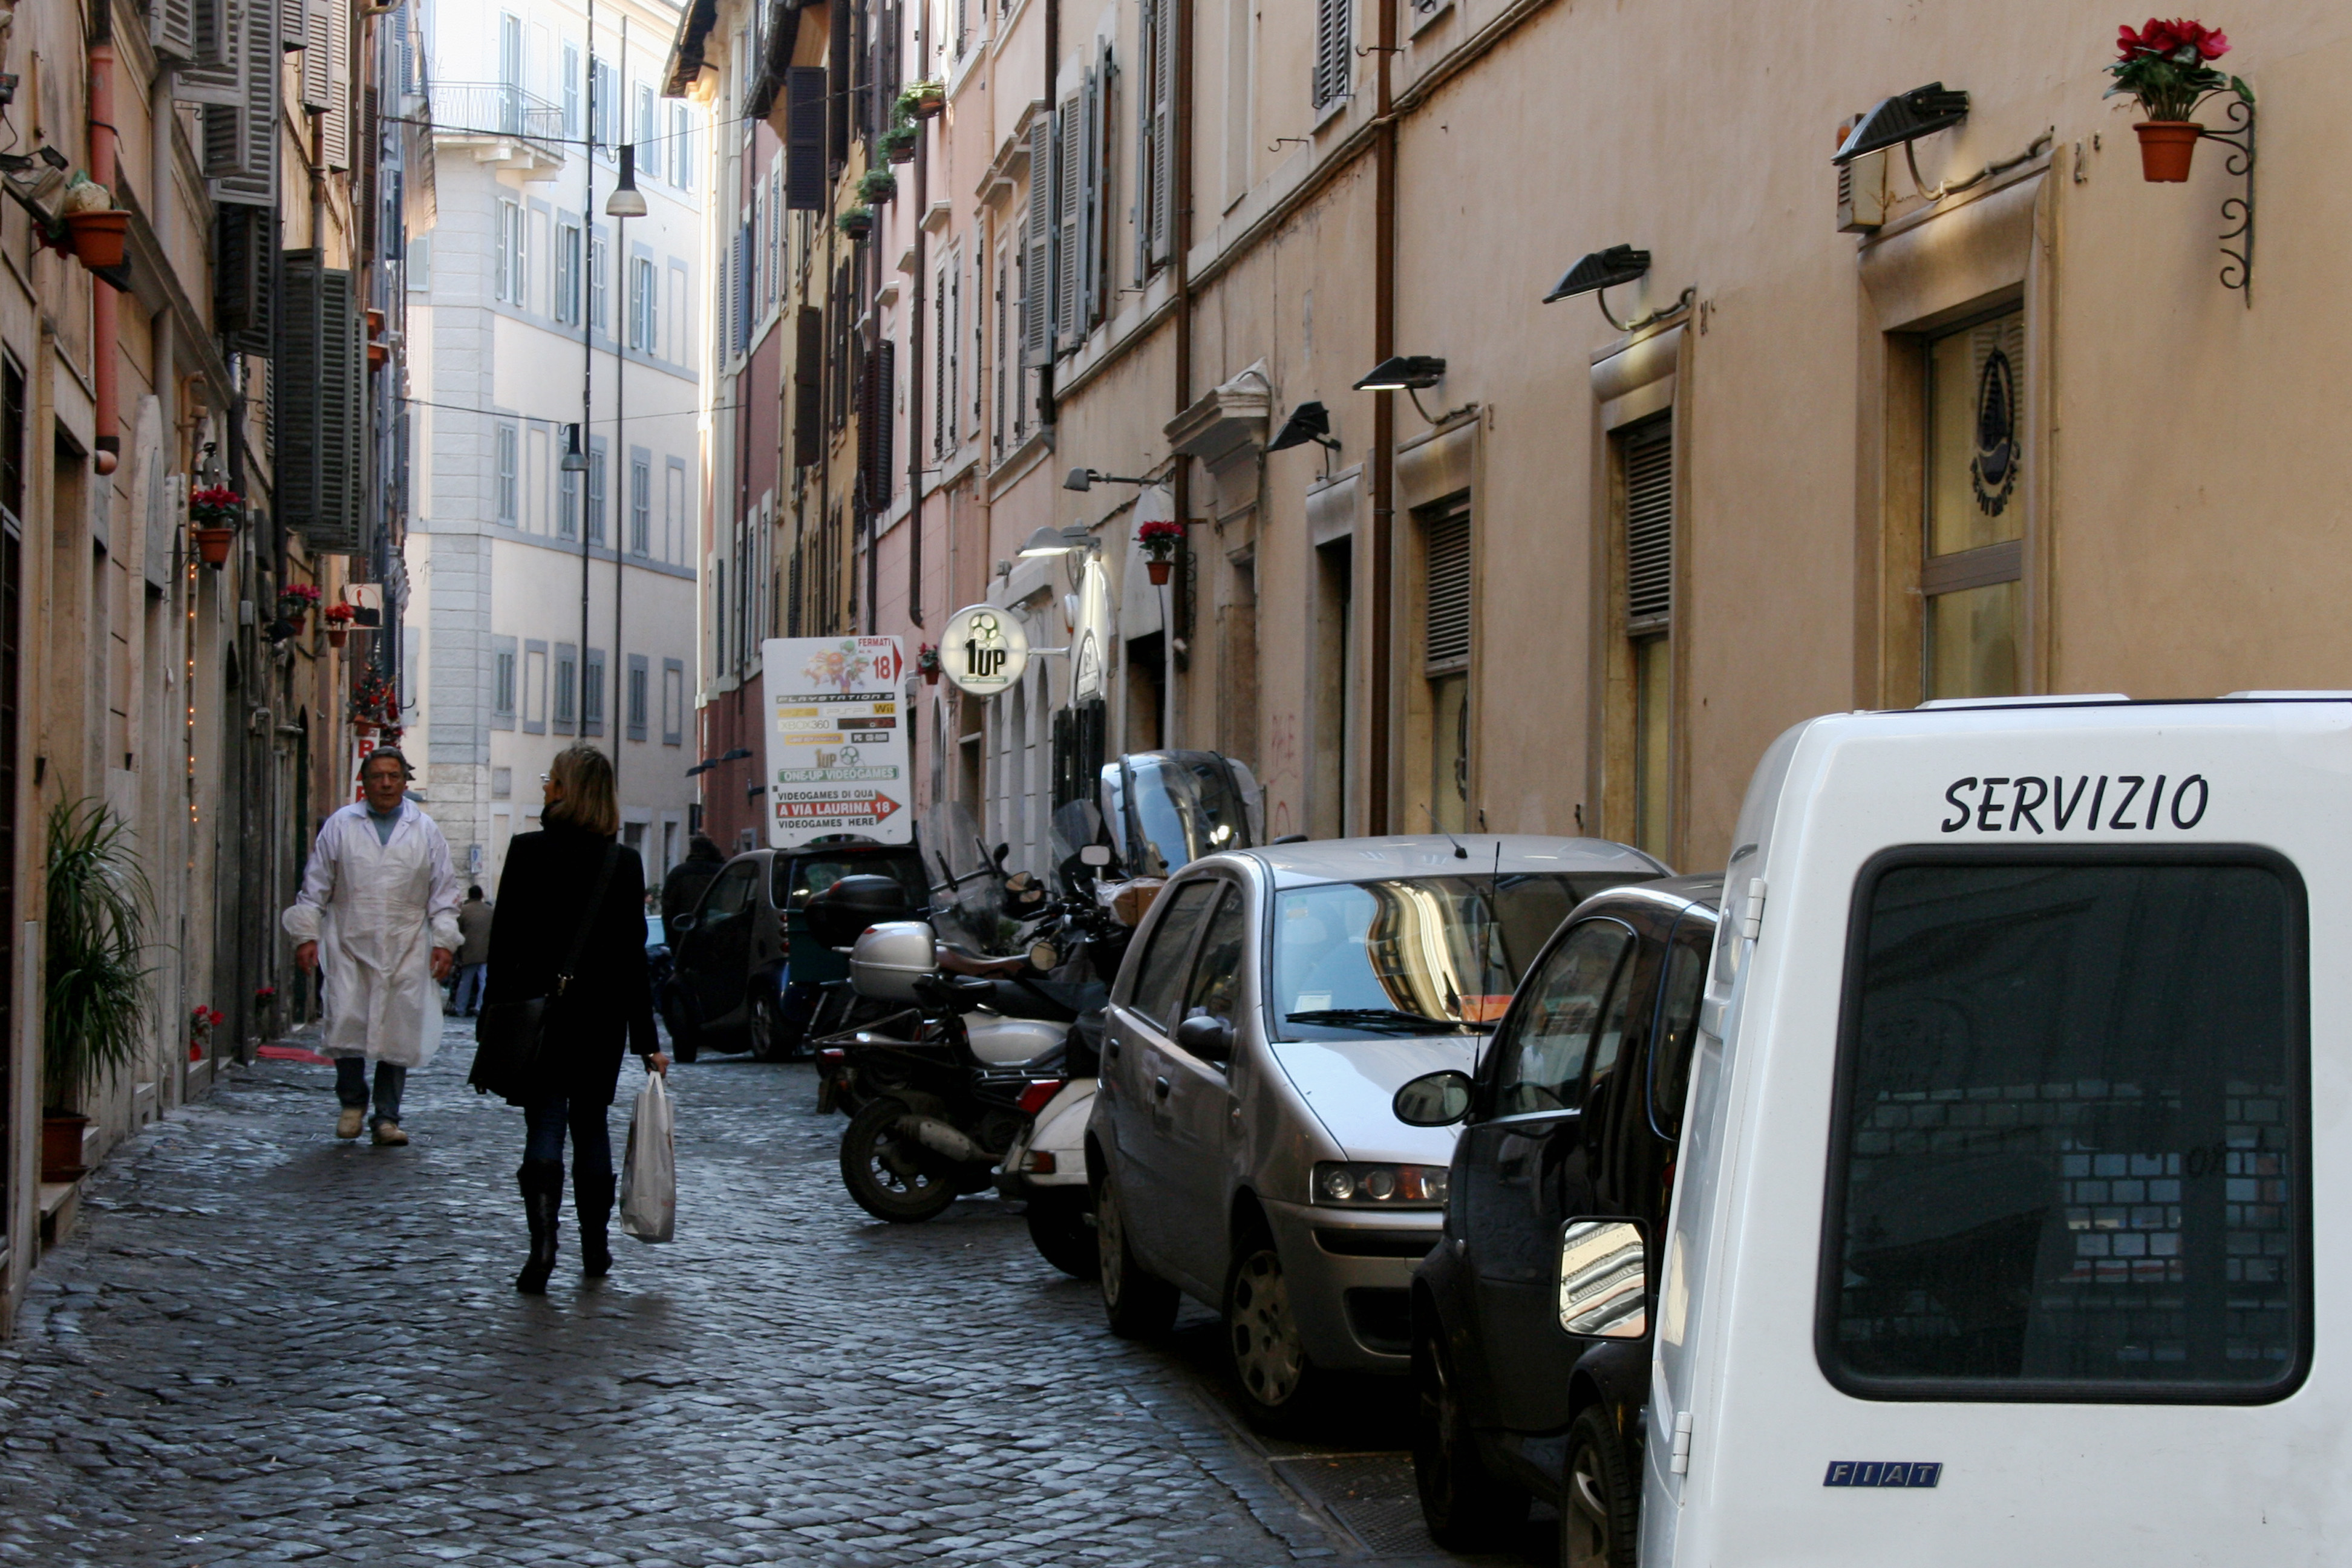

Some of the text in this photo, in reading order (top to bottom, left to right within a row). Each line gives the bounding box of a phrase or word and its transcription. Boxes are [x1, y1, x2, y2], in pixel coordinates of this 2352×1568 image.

[858, 638, 891, 647] FERMATI
[965, 639, 1006, 676] 1UP
[873, 656, 891, 679] 18
[874, 704, 894, 713] Wii
[815, 749, 837, 768] 1UP
[784, 768, 894, 781] ONE-UP VIDEOGAMES
[778, 791, 839, 801] VIDEOGAMES
[854, 789, 874, 798] QUA
[779, 801, 890, 816] A VIA LAURINA 18
[1940, 773, 2209, 835] SERVIZIO
[778, 818, 874, 829] VIDEOGAMES HERE
[1831, 1464, 1936, 1483] FIAT
